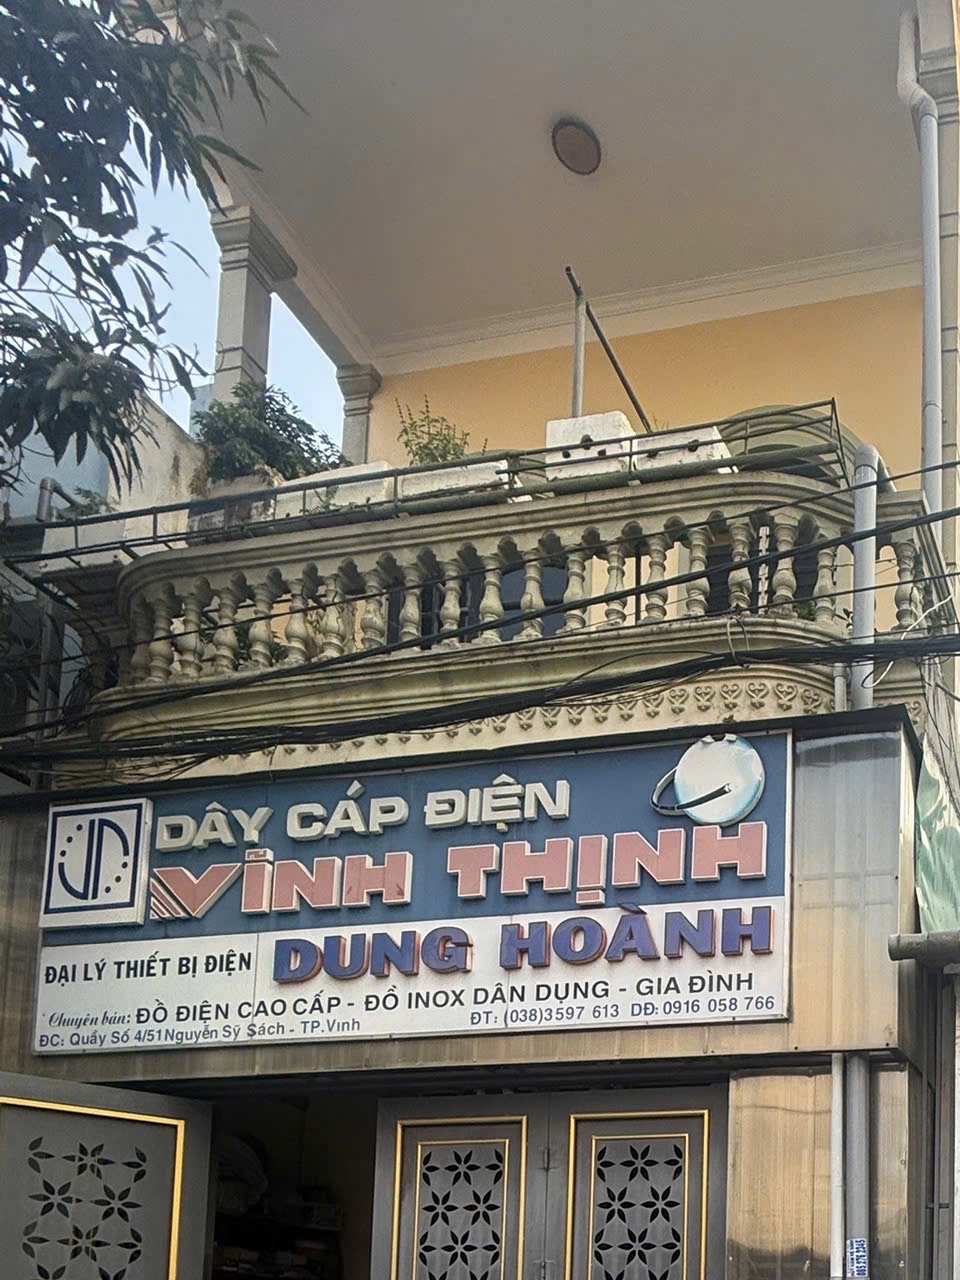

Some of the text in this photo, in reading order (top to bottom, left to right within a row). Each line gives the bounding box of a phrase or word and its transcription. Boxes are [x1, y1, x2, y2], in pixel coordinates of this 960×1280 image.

[156, 773, 570, 850] DÂY CÁP ĐIỆN
[150, 821, 767, 919] VĨNH THỊNH
[44, 949, 252, 987] ĐẠI LÝ THIẾT BỊ ĐIỆN
[273, 903, 774, 984] DUNG HOÀNH
[48, 1011, 99, 1029] Chuyên
[101, 1010, 131, 1025] bán:
[135, 999, 168, 1024] ĐỒ
[175, 1000, 229, 1023] ĐIỆN
[237, 999, 287, 1018] CAO
[292, 989, 341, 1015] CẤP
[364, 985, 399, 1011] ĐỒ
[407, 989, 465, 1009] INOX
[473, 983, 526, 1005] DÂN
[535, 980, 610, 1004] DỤNG
[636, 977, 681, 996] GIA
[688, 970, 753, 993] ĐÌNH
[470, 996, 775, 1027] ĐT: (038)3597 613 DĐ: 0916 058 766
[39, 1034, 64, 1047] ĐC:
[69, 1030, 107, 1047] Quầy
[110, 1028, 129, 1044] Số
[222, 1025, 241, 1041] Sỹ
[247, 1022, 285, 1037] Sách
